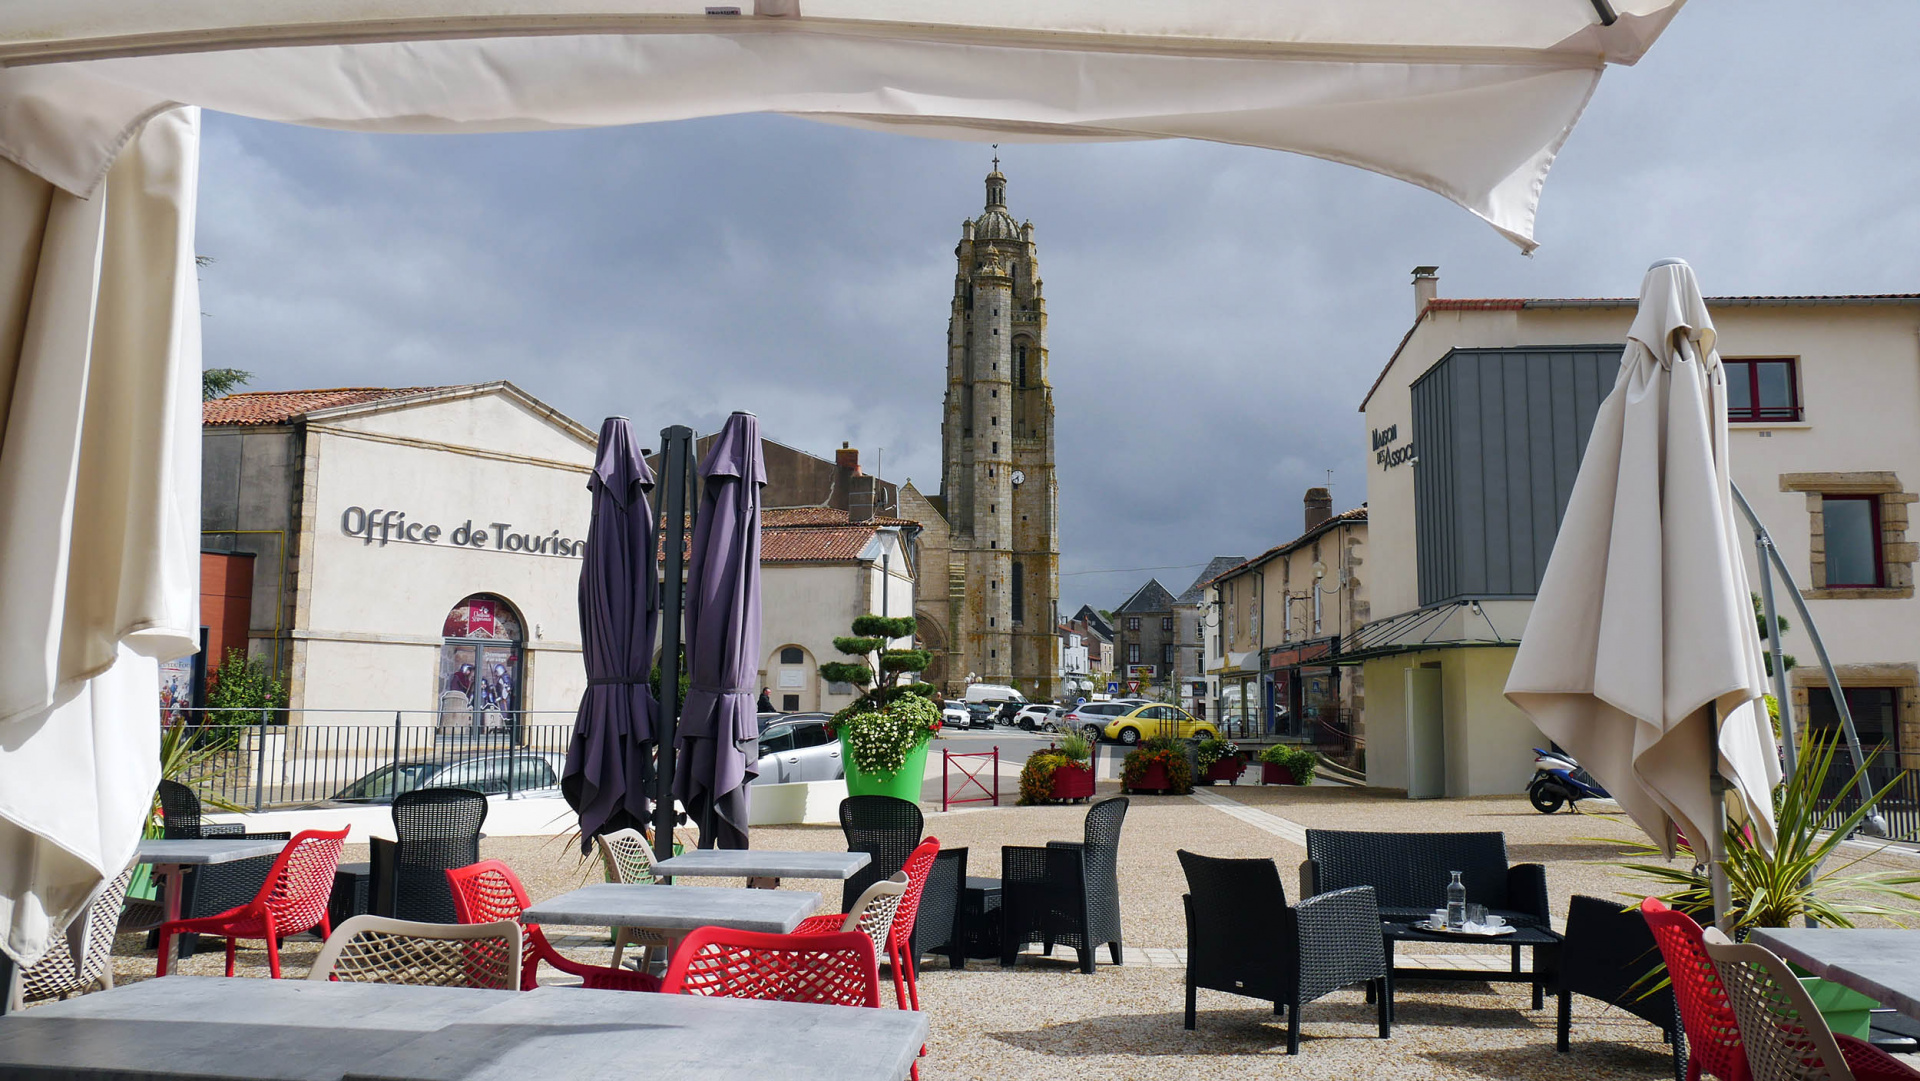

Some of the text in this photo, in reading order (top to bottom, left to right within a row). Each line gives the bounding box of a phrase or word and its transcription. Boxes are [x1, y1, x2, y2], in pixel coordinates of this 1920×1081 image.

[1372, 424, 1397, 451] MAISON
[342, 506, 441, 546] Office
[452, 520, 488, 547] de
